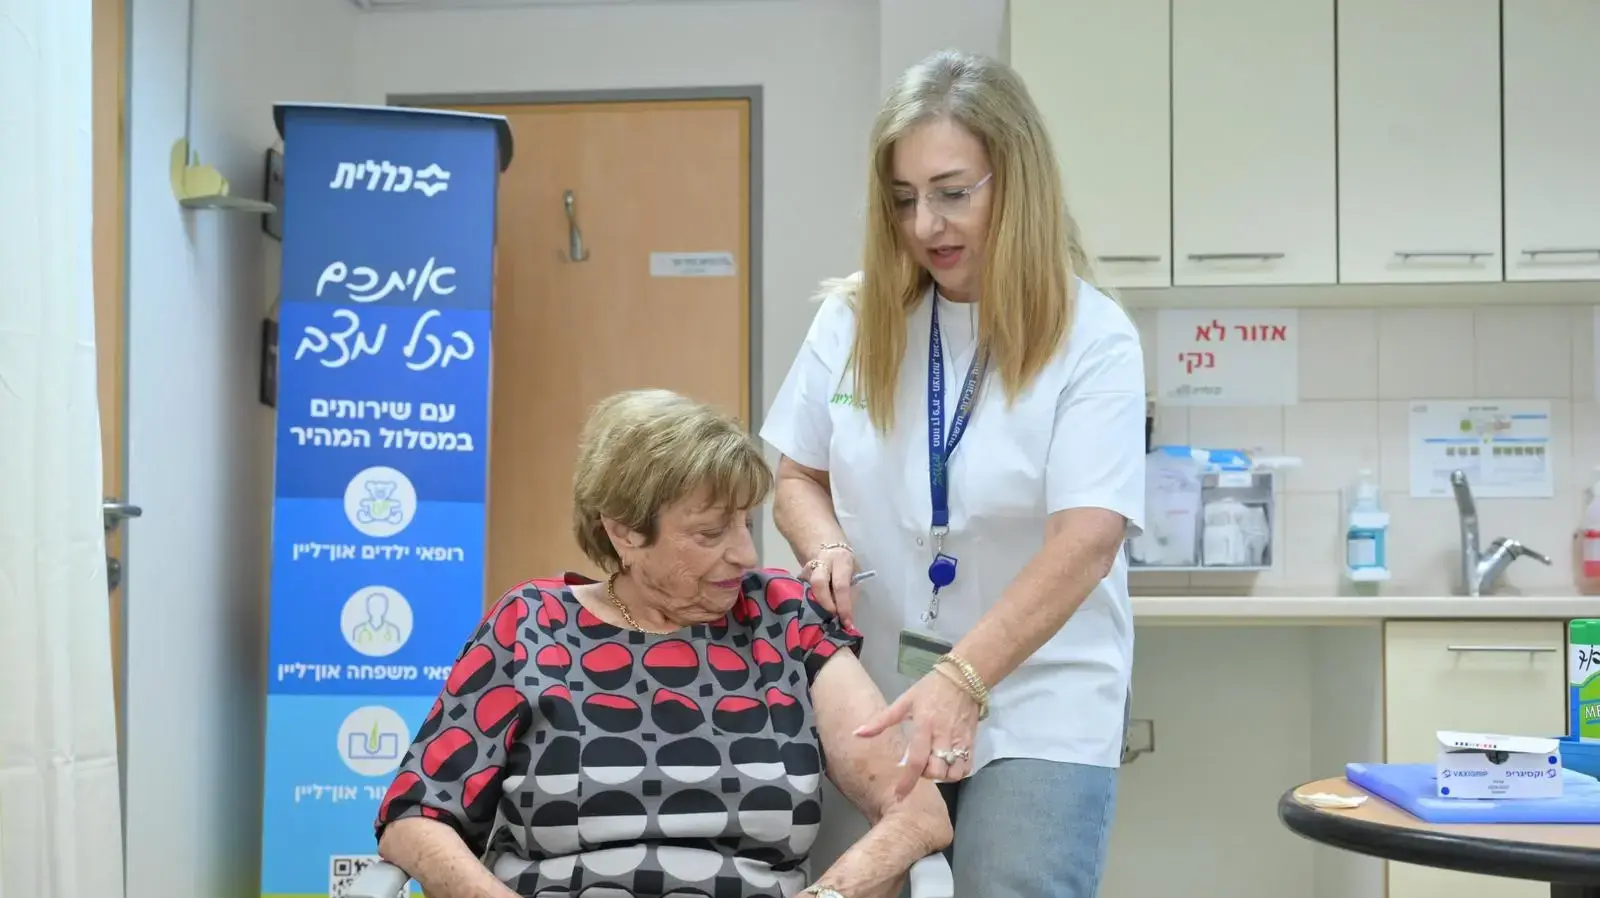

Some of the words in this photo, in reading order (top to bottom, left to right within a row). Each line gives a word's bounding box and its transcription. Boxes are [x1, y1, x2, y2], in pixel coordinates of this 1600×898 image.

[330, 160, 413, 193] כללית
[316, 257, 457, 302] איתכם
[295, 309, 387, 369] מצב
[403, 309, 475, 371] בכל
[1195, 319, 1226, 341] לא
[1233, 324, 1287, 341] אזור
[1178, 352, 1215, 374] נקי
[311, 399, 412, 421] שירותים
[420, 403, 456, 423] עם
[290, 427, 371, 447] המהיר
[379, 427, 474, 451] במסלול
[362, 544, 411, 559] ילדים
[416, 547, 464, 561] רופאי
[347, 665, 417, 680] משפחה
[423, 665, 452, 680] פאי
[1505, 770, 1544, 779] וקסיגריפ
